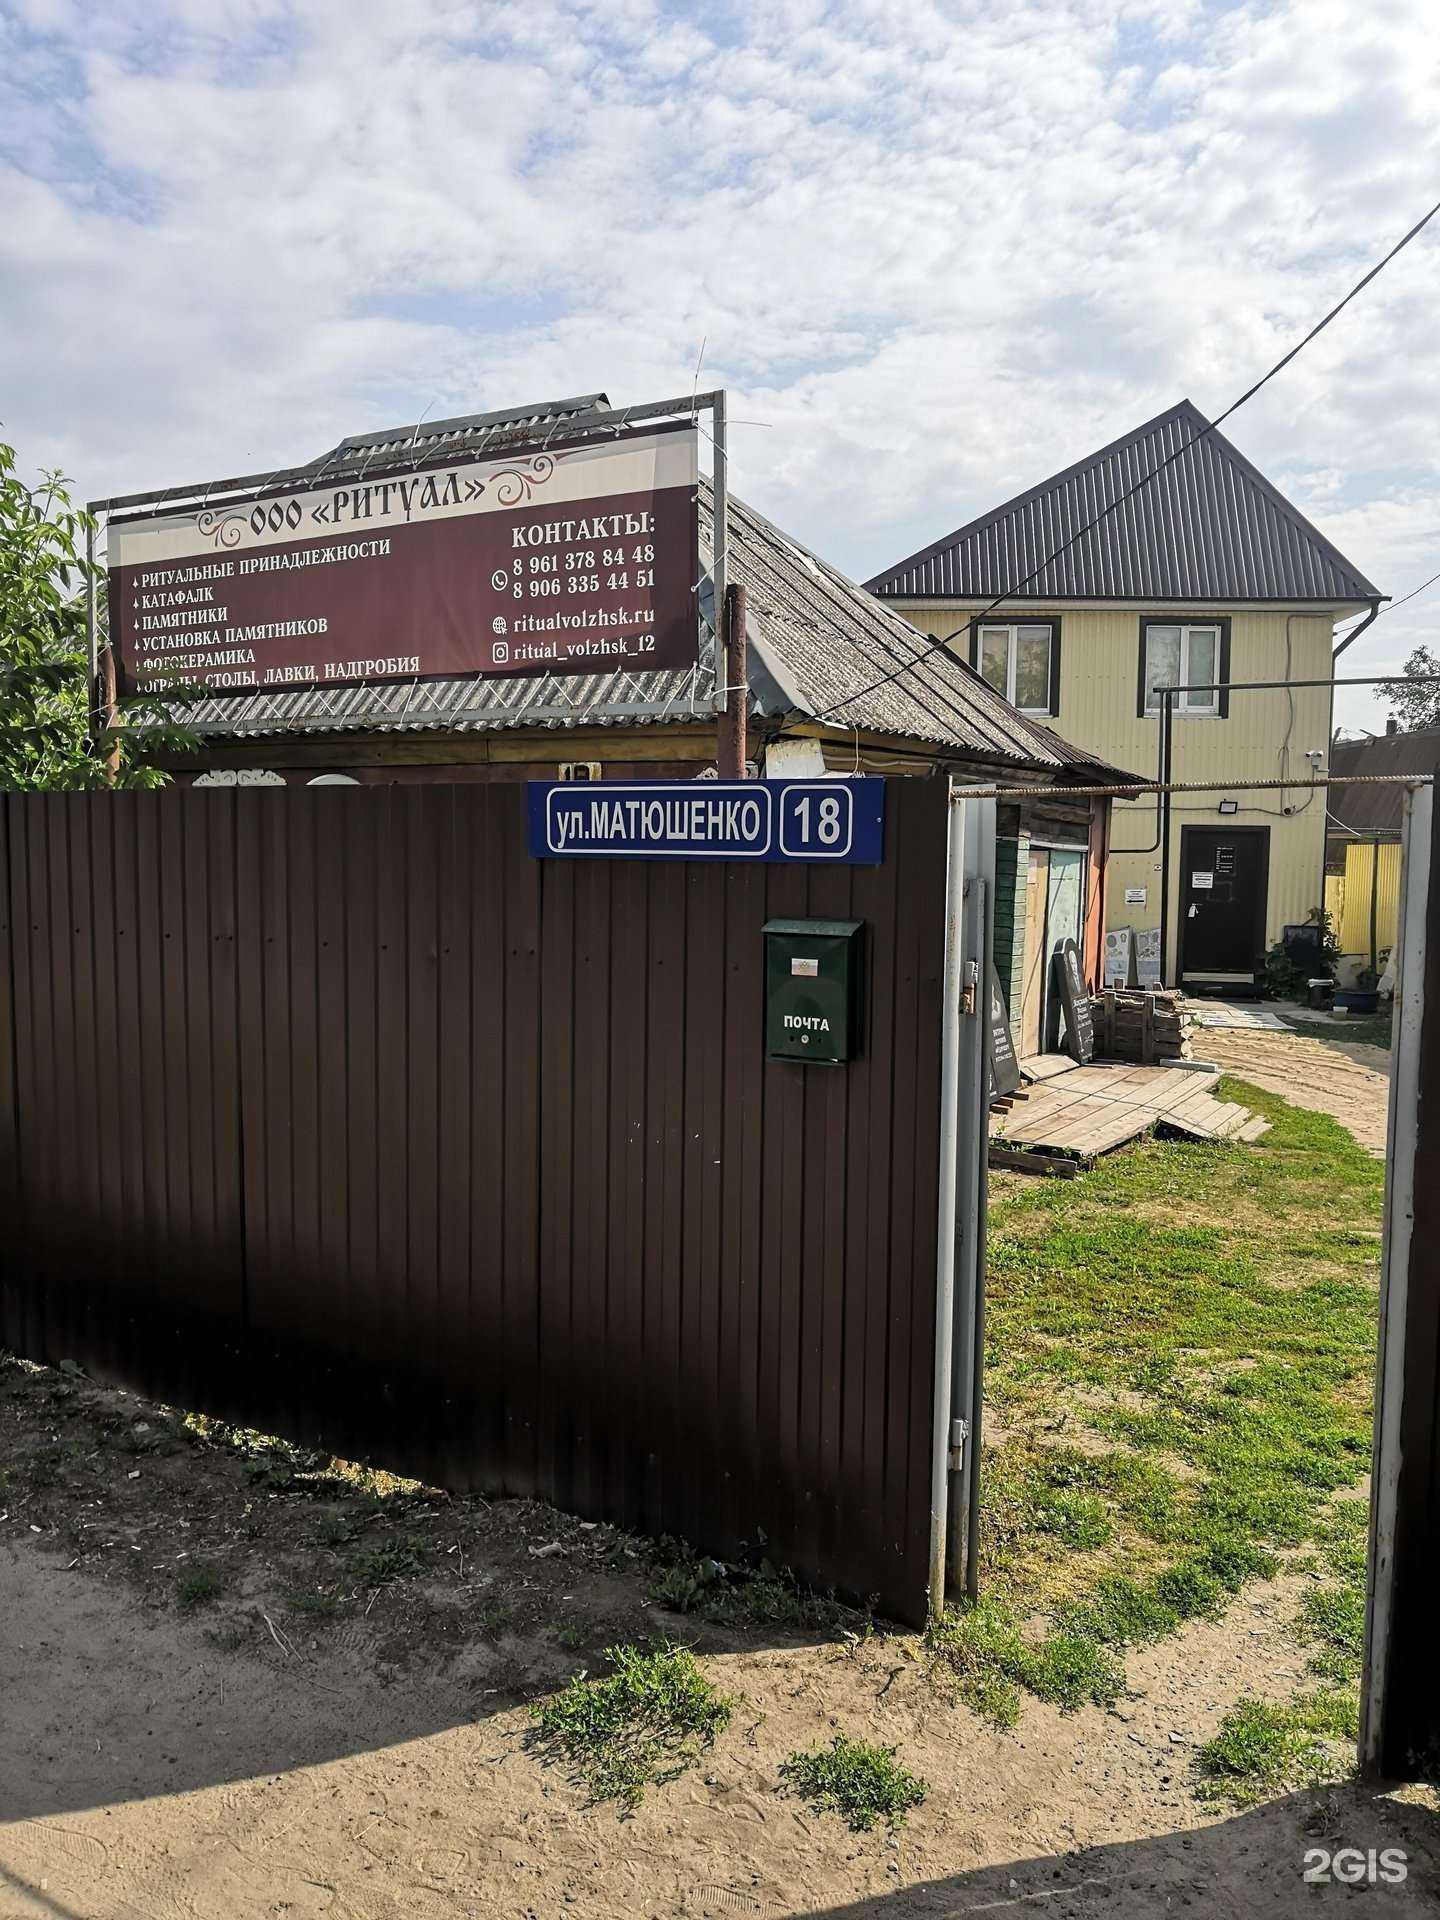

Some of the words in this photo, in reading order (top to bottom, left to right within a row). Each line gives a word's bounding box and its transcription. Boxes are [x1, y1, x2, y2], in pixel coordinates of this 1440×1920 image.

[250, 499, 301, 536] ООО
[311, 472, 486, 525] «РИТУАЛ»
[512, 511, 655, 548] КОНТАКТЫ:
[142, 562, 235, 588] РИТУАЛЬНЫЕ
[239, 538, 391, 575] ПРИНАДЛЕЖНОСТИ
[513, 558, 523, 576] 8
[529, 555, 558, 574] 961
[565, 551, 596, 570] 378
[602, 548, 625, 567] 84
[632, 544, 655, 563] 48
[142, 586, 214, 609] КАТАФАЛК
[513, 582, 523, 599] 8
[529, 578, 561, 597] 906
[567, 574, 600, 594] 335
[607, 572, 629, 590] 44
[636, 569, 655, 588] 51
[142, 606, 228, 630] ПАМЯТНИКИ
[142, 629, 221, 651] УСТАНОВКА
[225, 617, 328, 643] ПАМЯТНИКОВ
[514, 606, 655, 633] ritualvolzhsk.ru
[514, 634, 655, 661] ritual_volzhsk_12
[205, 670, 260, 689] СТОЛЫ,
[264, 665, 319, 684] ЛАВКИ,
[324, 656, 420, 679] НАДГРОБИЯ
[556, 799, 760, 849] ул.МАТЮШЕНКО
[794, 796, 840, 845] 18
[784, 1015, 830, 1031] ПОЧТА
